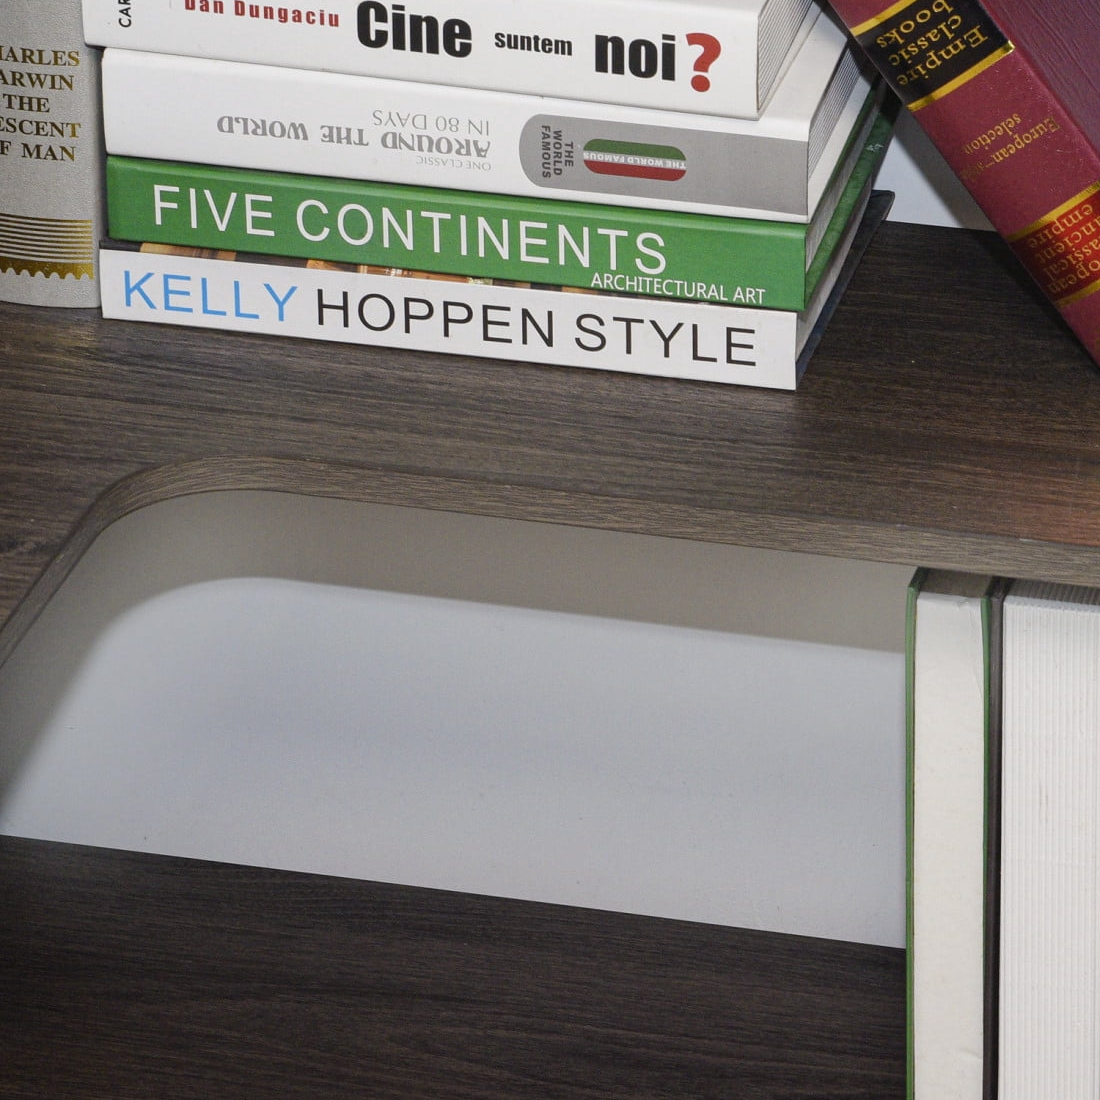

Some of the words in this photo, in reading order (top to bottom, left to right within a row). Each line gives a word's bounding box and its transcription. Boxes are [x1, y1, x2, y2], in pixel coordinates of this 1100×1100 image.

[234, 0, 341, 28] Dungaciu
[355, 0, 474, 58] Cine
[494, 29, 574, 57] suntem
[594, 31, 723, 93] noi?
[888, 15, 961, 66] classic
[896, 25, 988, 85] Empire
[2, 93, 51, 114] THE
[215, 114, 310, 143] WORLD
[371, 109, 428, 131] DAYS
[435, 115, 462, 133] 80
[467, 119, 492, 136] IN
[318, 125, 372, 146] THE
[381, 133, 492, 159] AROUND
[963, 113, 1021, 154] selection
[20, 142, 77, 162] MAN
[415, 155, 463, 170] CLASSIC
[541, 125, 551, 178] FAMOUS
[552, 130, 562, 176] WORLD
[565, 142, 574, 167] THE
[583, 152, 625, 164] FAMOUS
[627, 155, 663, 168] WORLD
[664, 158, 687, 170] THE
[466, 160, 492, 172] ONE
[153, 184, 275, 235] FIVE
[296, 199, 668, 277] CONTINENTS
[1028, 204, 1093, 248] empire
[590, 271, 727, 302] ARCHITECTURAL
[731, 287, 767, 305] ART
[124, 270, 298, 321] KELLY
[318, 289, 553, 348] HOPPEN
[576, 313, 757, 366] STYLE
